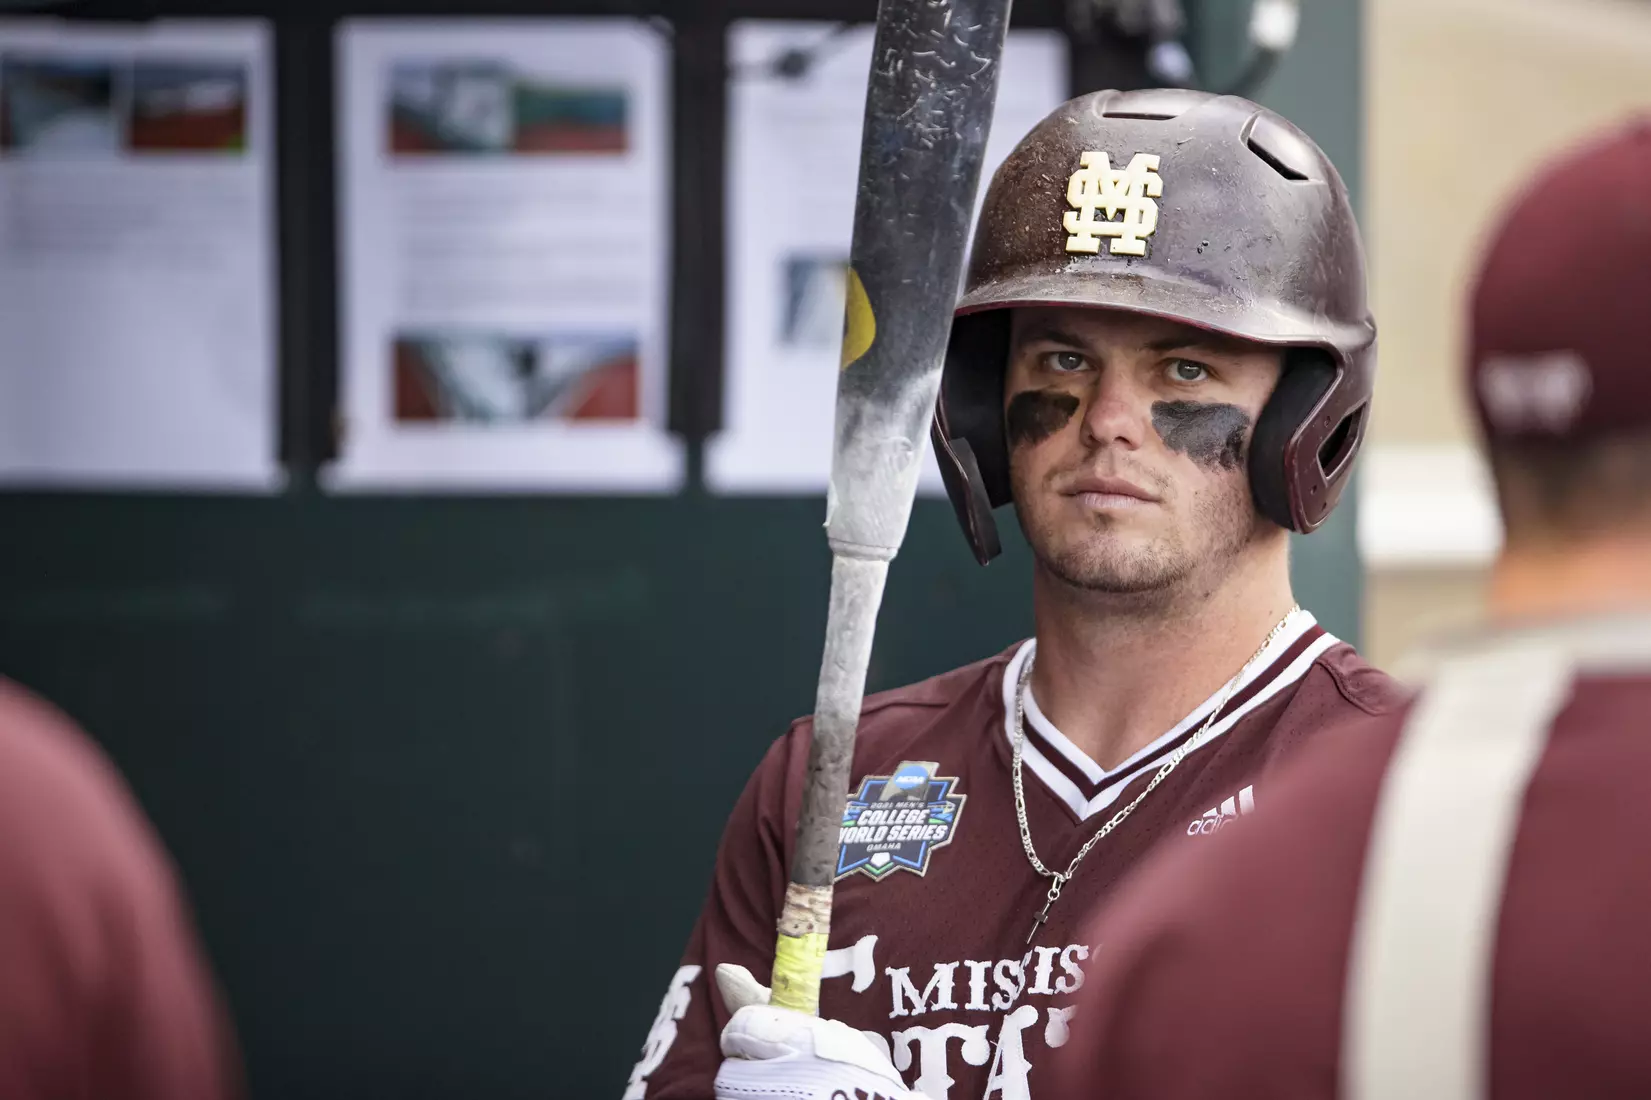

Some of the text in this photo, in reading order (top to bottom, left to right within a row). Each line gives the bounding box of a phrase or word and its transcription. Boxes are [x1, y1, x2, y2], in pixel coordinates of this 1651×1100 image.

[857, 809, 930, 826] COLLEGE
[887, 825, 948, 841] SERIES
[866, 842, 902, 852] OMAHA
